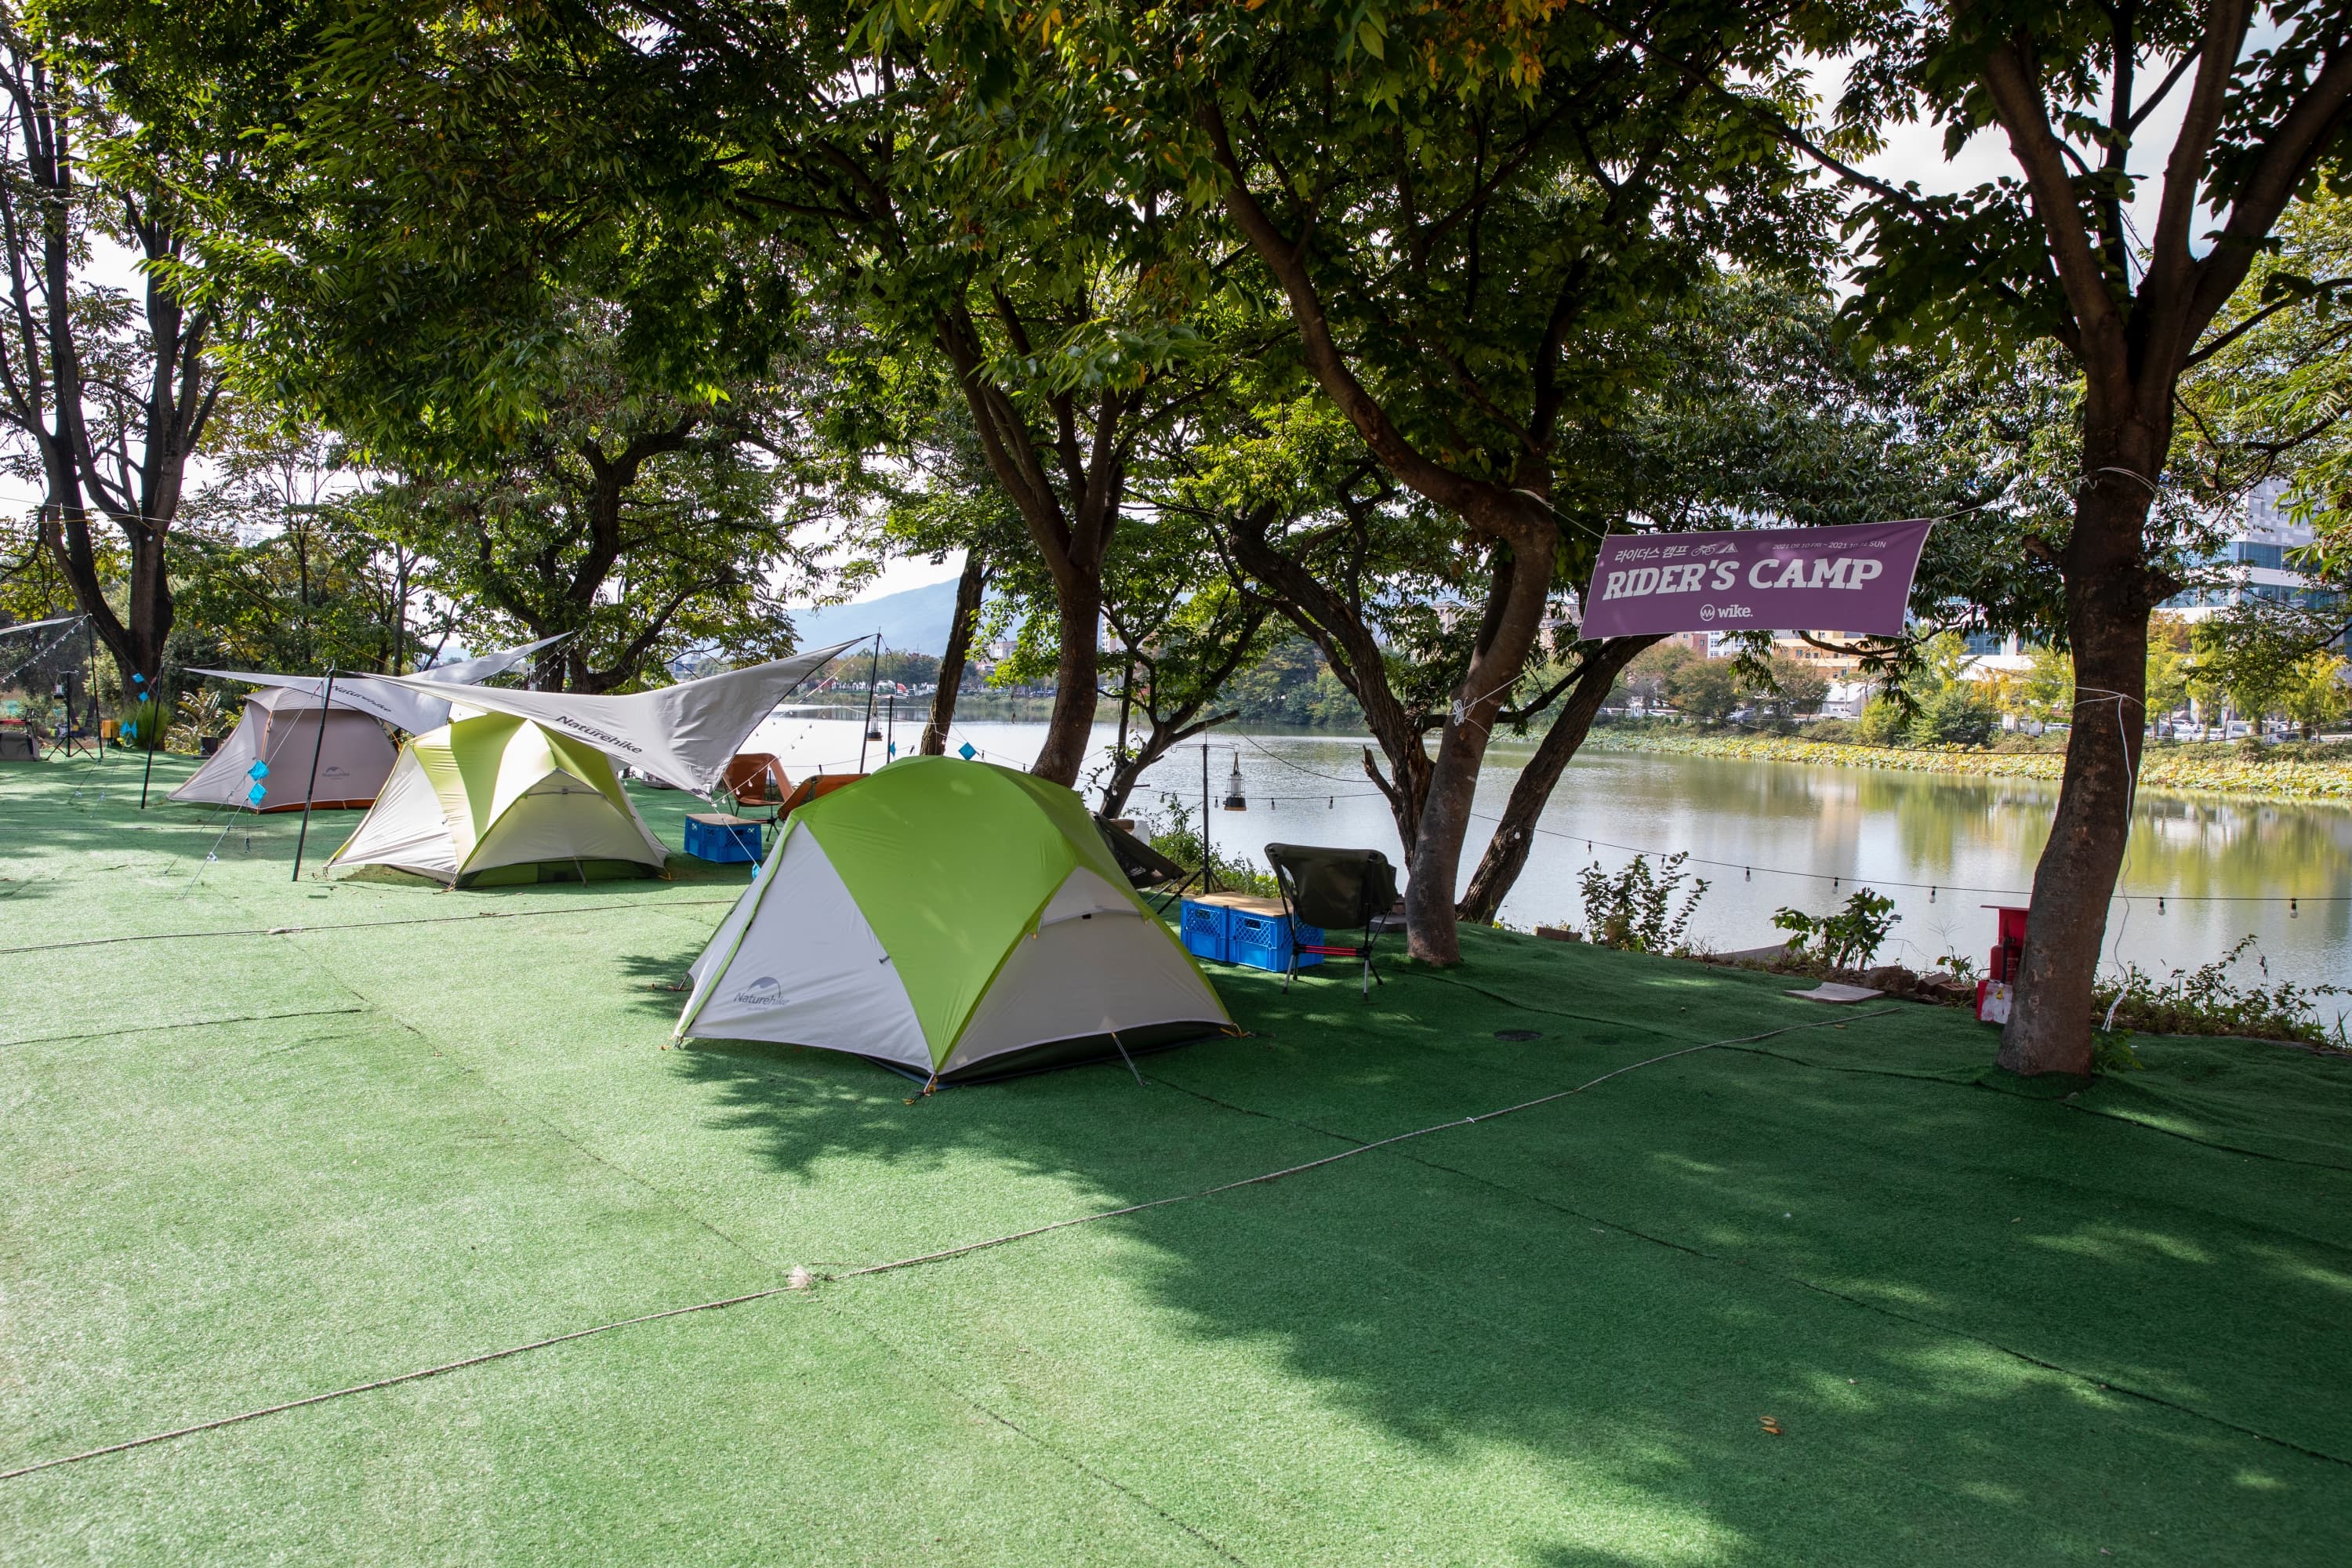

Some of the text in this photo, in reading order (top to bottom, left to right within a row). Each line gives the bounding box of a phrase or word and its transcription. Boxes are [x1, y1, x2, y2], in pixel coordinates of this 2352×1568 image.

[1614, 545, 1690, 563] 라이더스 캠프
[1602, 557, 1883, 601] RIDER'S CAMP
[555, 715, 643, 753] Naturehike
[733, 992, 790, 1005] Naturehike
